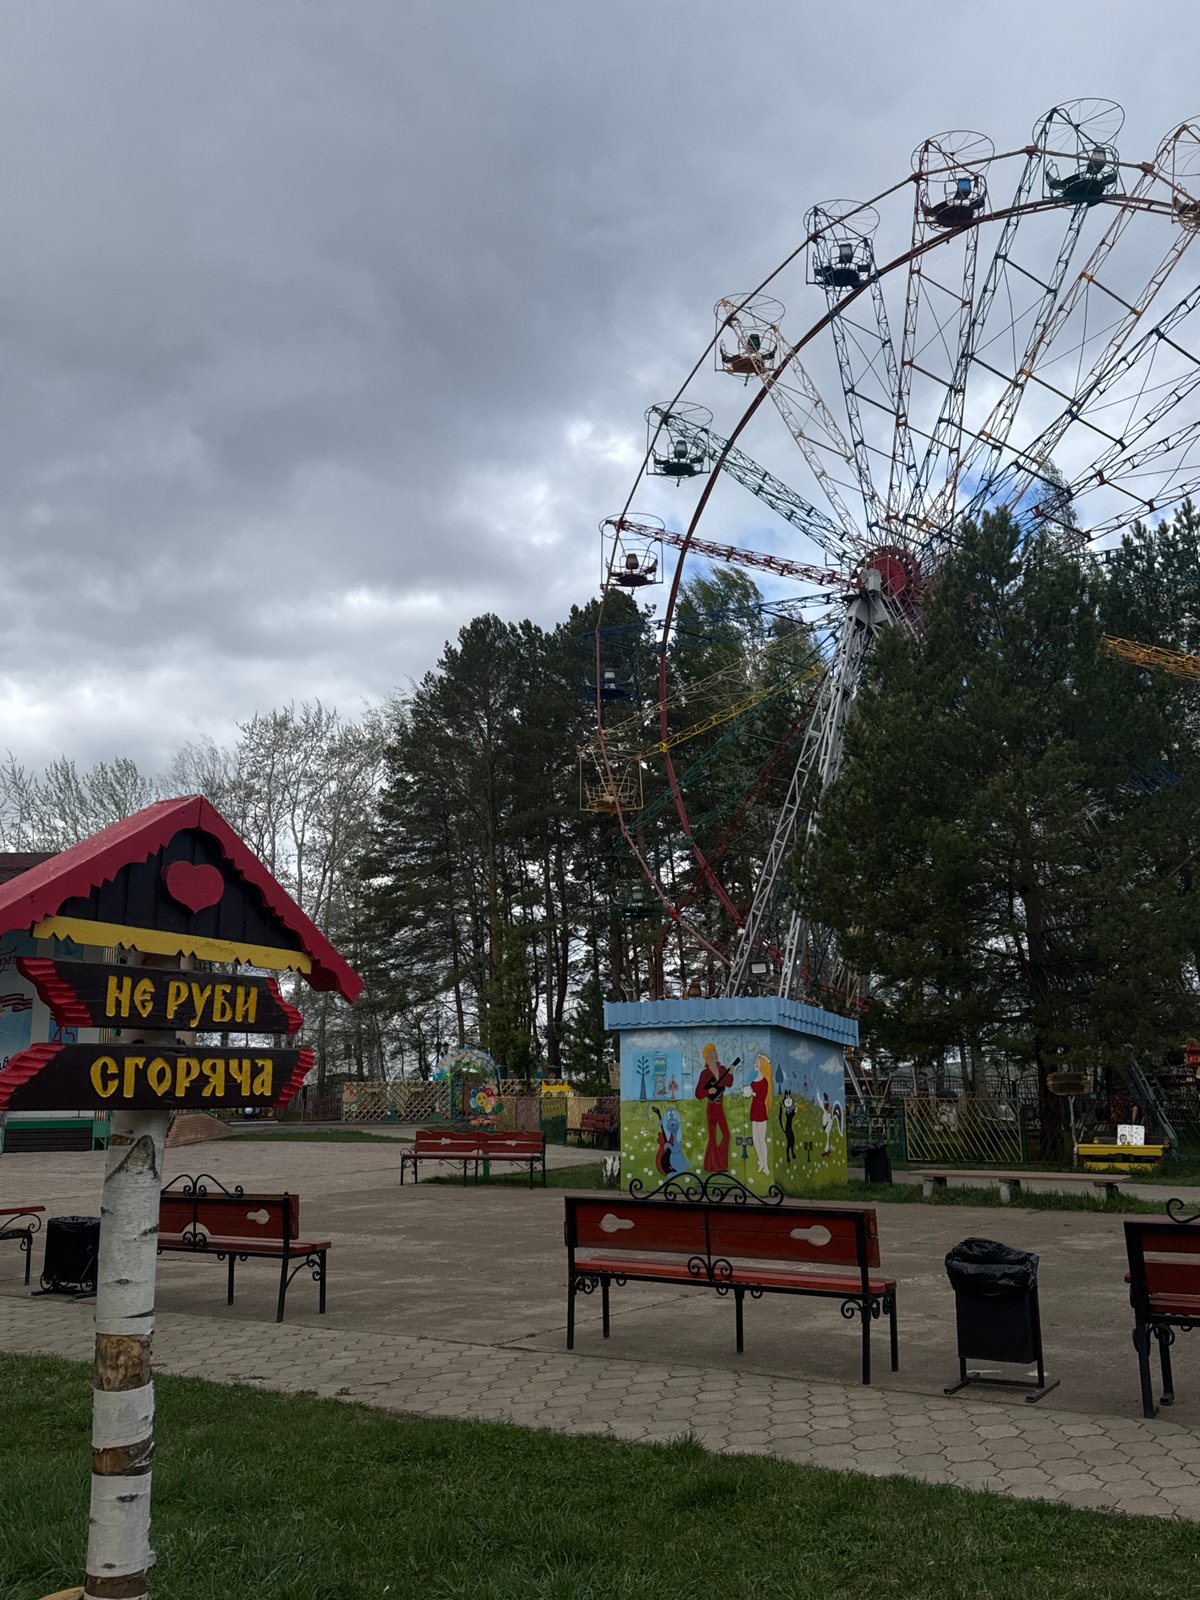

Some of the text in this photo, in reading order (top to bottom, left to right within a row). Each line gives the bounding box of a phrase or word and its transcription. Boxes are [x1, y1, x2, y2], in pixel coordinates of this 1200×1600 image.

[105, 975, 259, 1028] НЕ РУБИ
[90, 1056, 273, 1098] СГОРЯЧА
